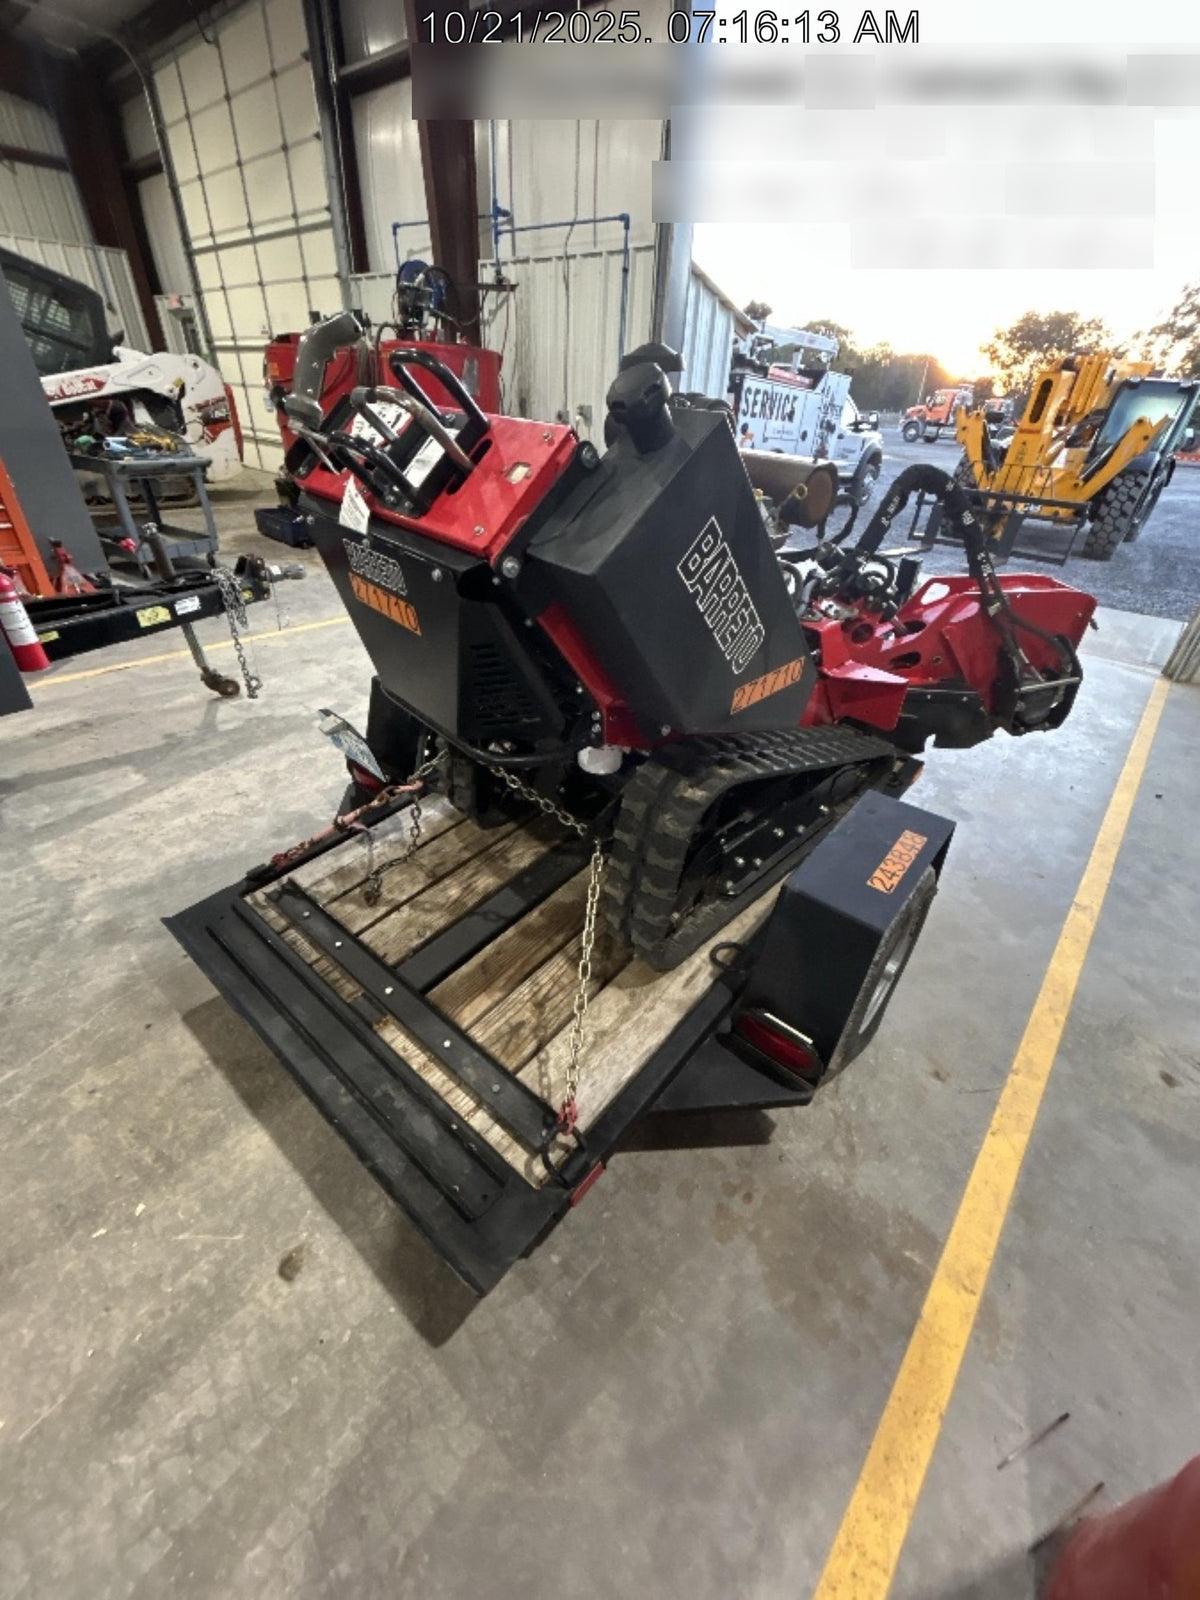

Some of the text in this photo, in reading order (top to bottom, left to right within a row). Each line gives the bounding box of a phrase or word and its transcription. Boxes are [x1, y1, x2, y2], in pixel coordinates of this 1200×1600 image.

[741, 386, 799, 422] SERVICE
[677, 515, 765, 675] BARRETO
[732, 657, 804, 713] 271710
[868, 831, 926, 893] 243848
